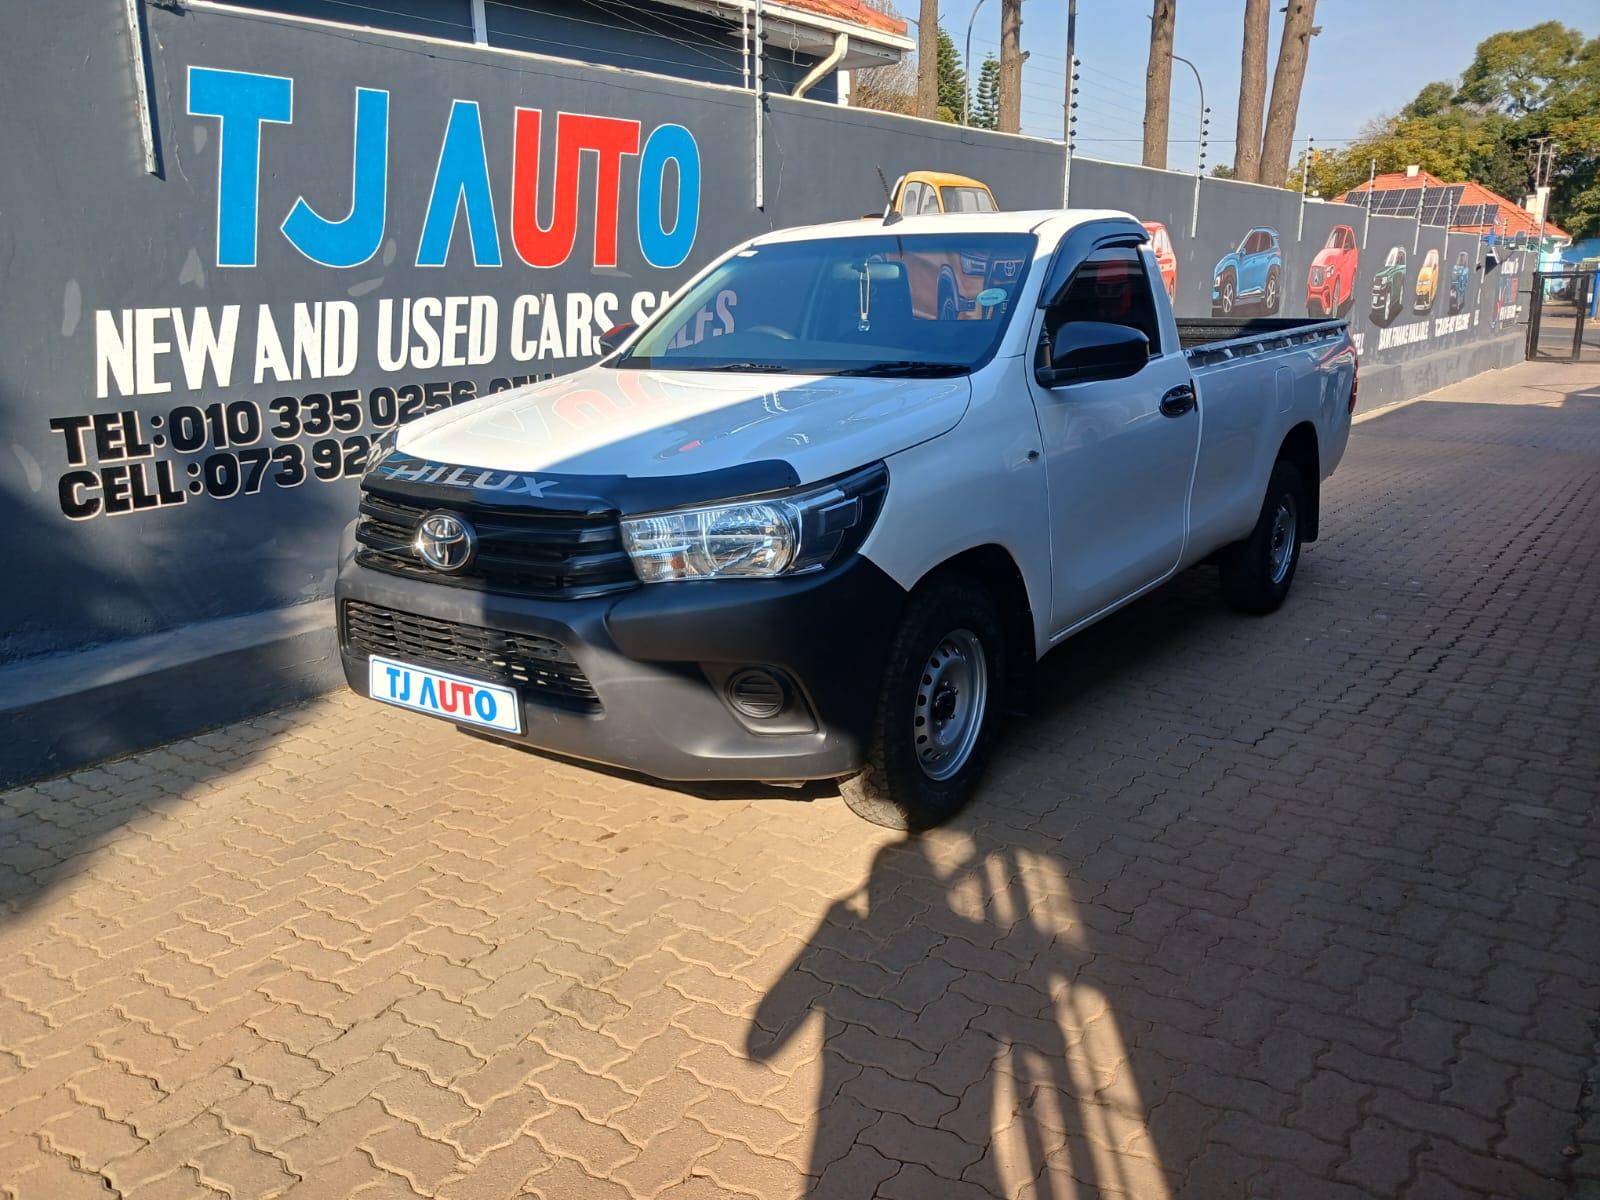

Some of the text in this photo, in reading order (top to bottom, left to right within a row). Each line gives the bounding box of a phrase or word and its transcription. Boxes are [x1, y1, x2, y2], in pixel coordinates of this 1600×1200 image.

[187, 65, 701, 269] TJ AUTO
[96, 304, 240, 398] NEW
[253, 300, 359, 384] AND
[377, 294, 497, 372] USED
[510, 291, 619, 360] CARS
[268, 388, 363, 441] 335
[312, 432, 378, 482] 92
[385, 464, 560, 498] HILUX
[386, 667, 498, 722] TJ AUTO
